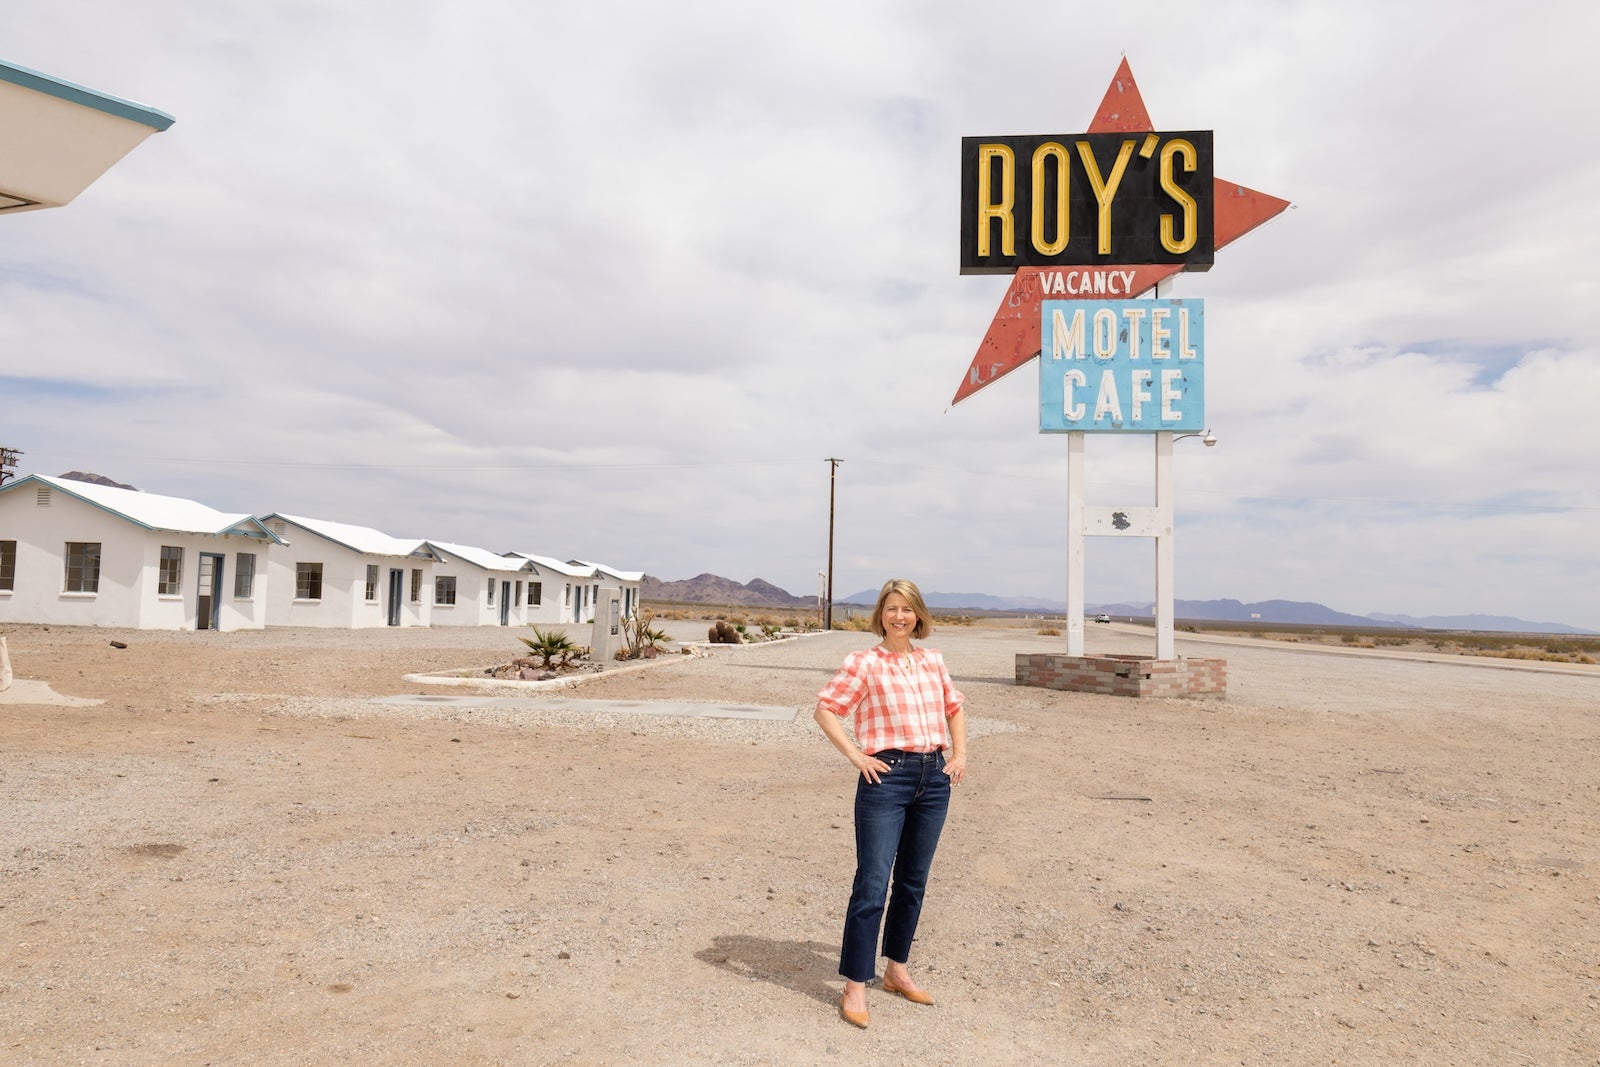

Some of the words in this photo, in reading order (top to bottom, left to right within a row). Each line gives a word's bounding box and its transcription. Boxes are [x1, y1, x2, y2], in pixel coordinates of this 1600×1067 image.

[978, 134, 1198, 256] ROY'S
[1040, 270, 1136, 294] VACANCY
[1052, 308, 1197, 360] MOTEL
[1063, 369, 1183, 421] CAFE
